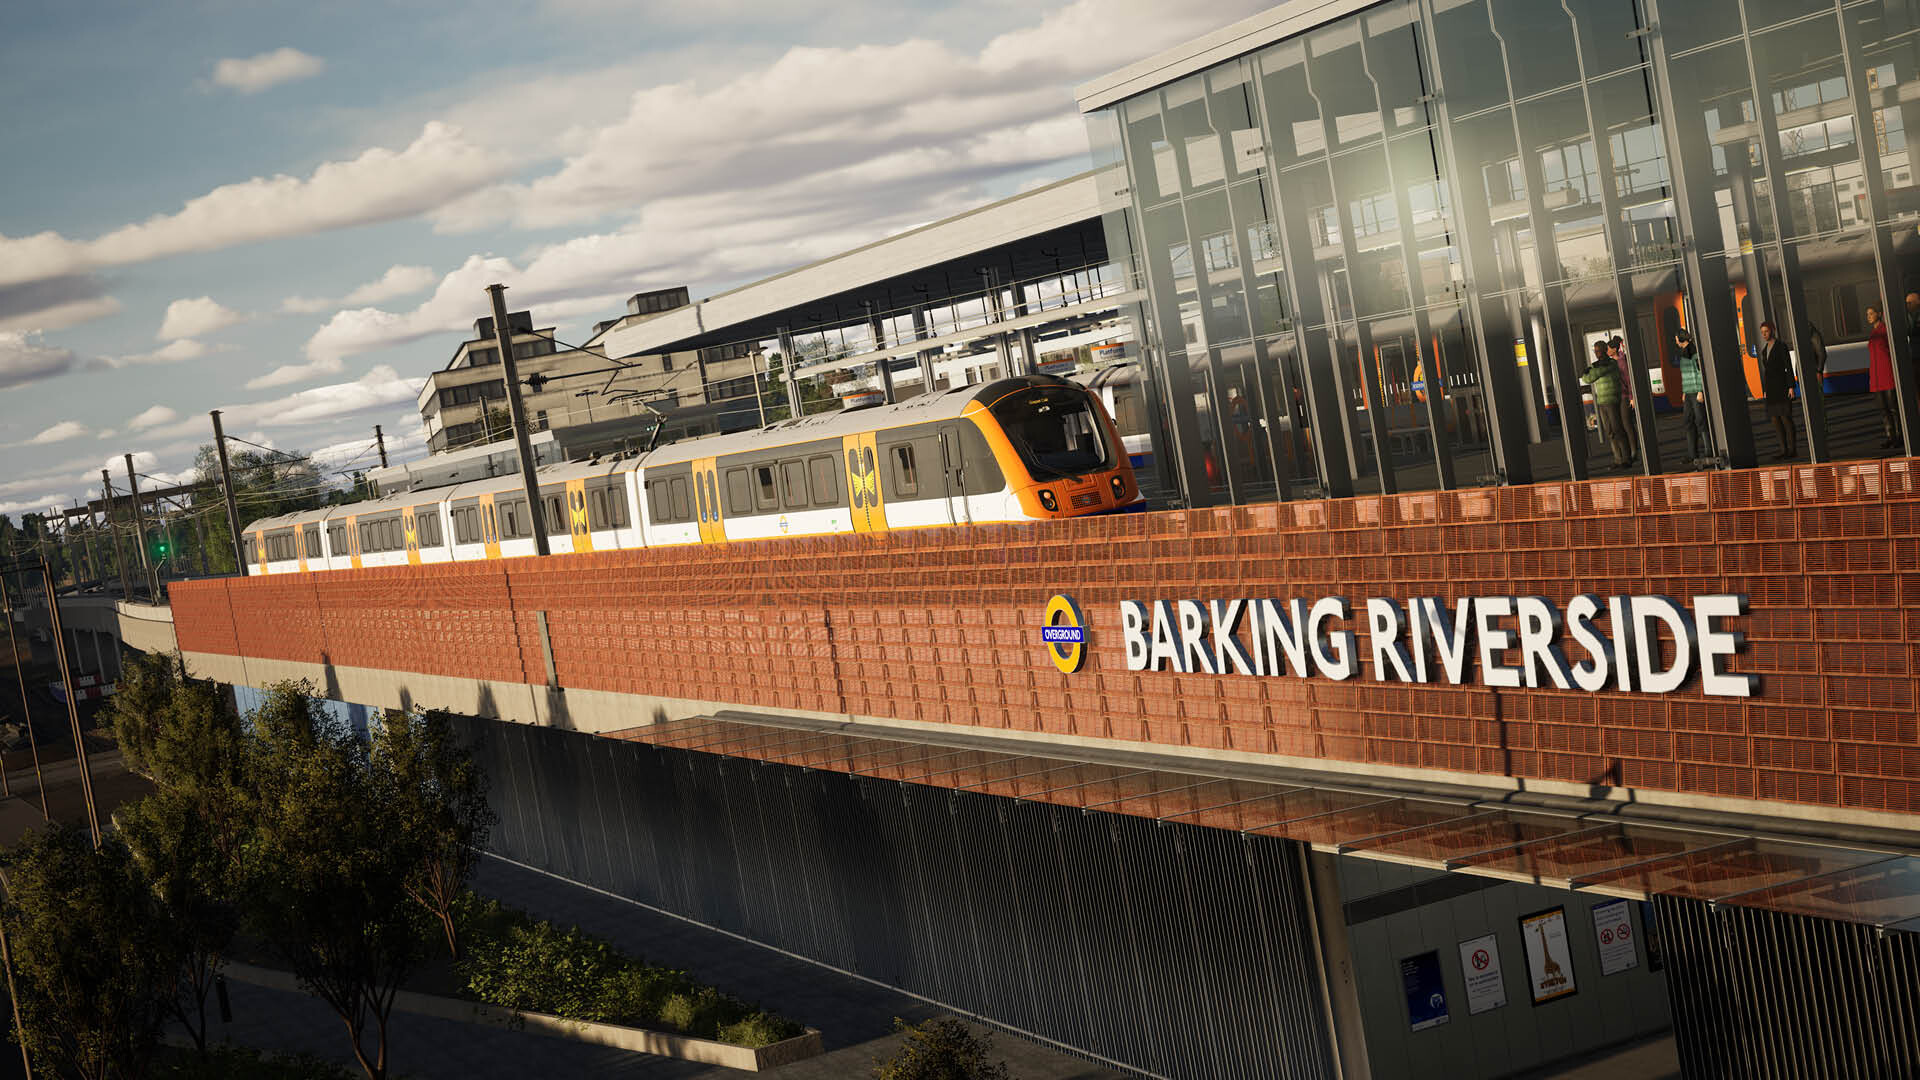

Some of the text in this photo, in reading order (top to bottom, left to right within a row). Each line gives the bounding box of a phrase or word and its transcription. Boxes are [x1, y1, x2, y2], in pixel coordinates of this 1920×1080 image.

[1044, 629, 1081, 641] OVERGROUND
[1120, 594, 1756, 697] BARKING RIVERSIDE
